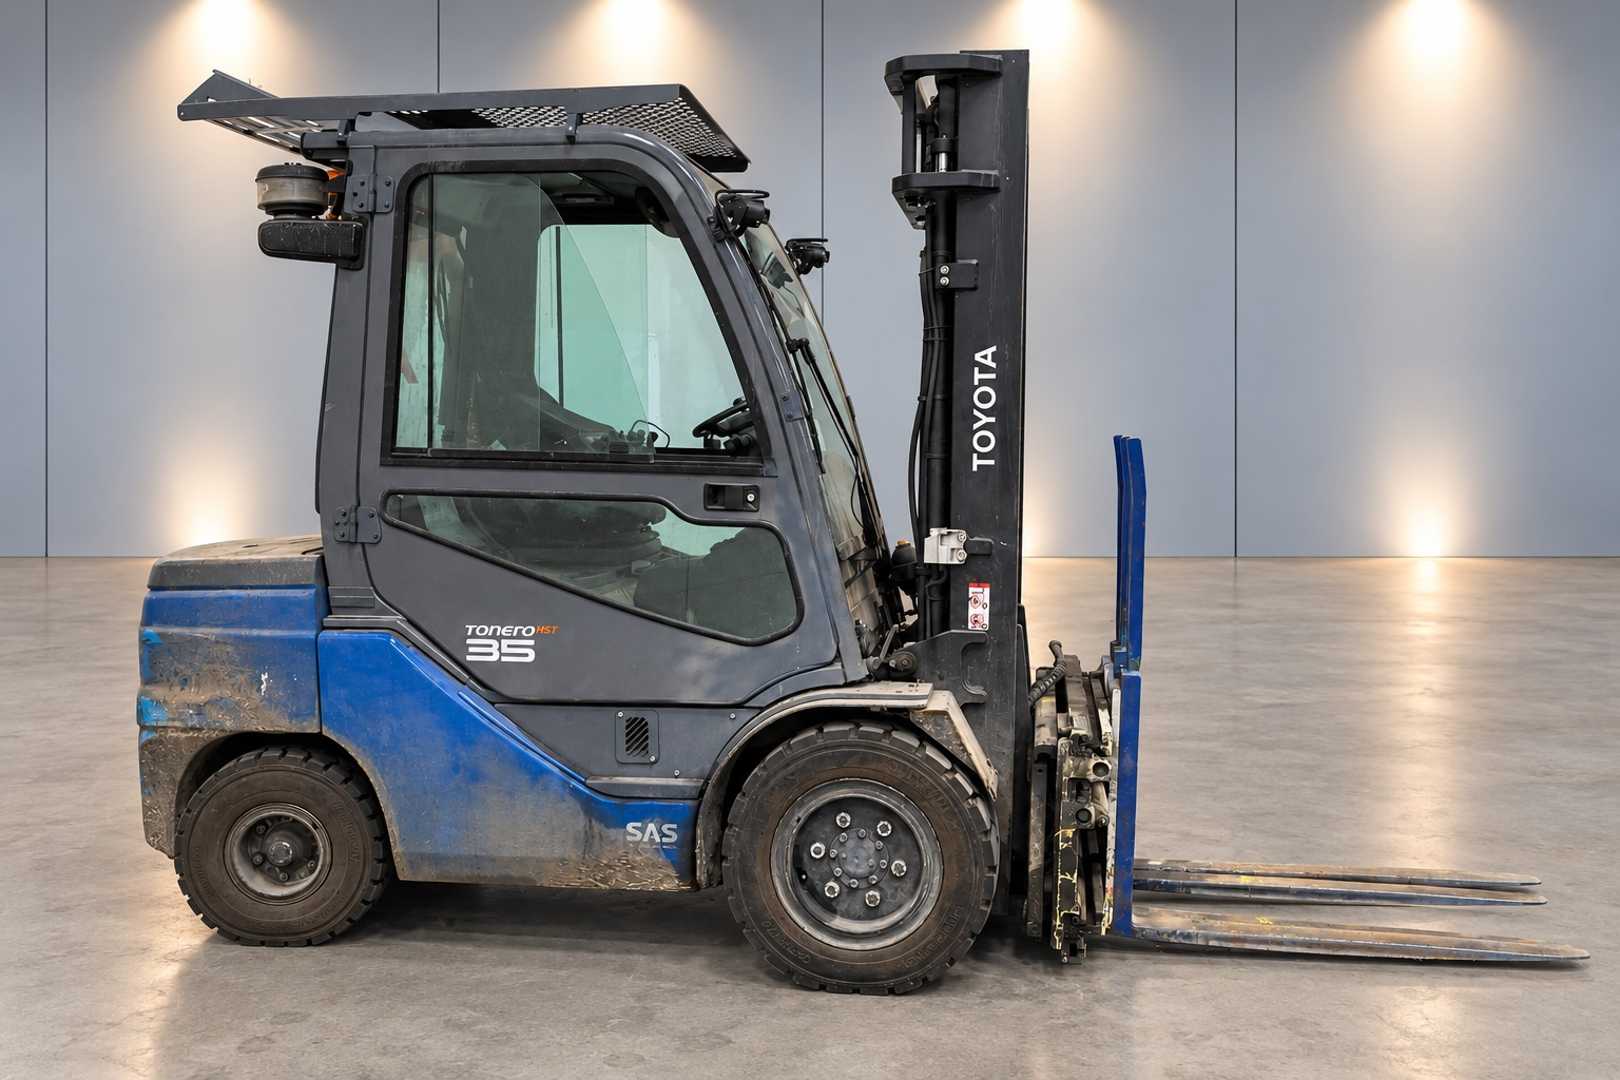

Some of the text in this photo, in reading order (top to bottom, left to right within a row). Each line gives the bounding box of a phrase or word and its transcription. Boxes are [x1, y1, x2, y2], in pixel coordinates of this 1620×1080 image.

[972, 345, 997, 471] TOYOTA
[465, 638, 536, 662] 35
[625, 821, 678, 843] SAS
